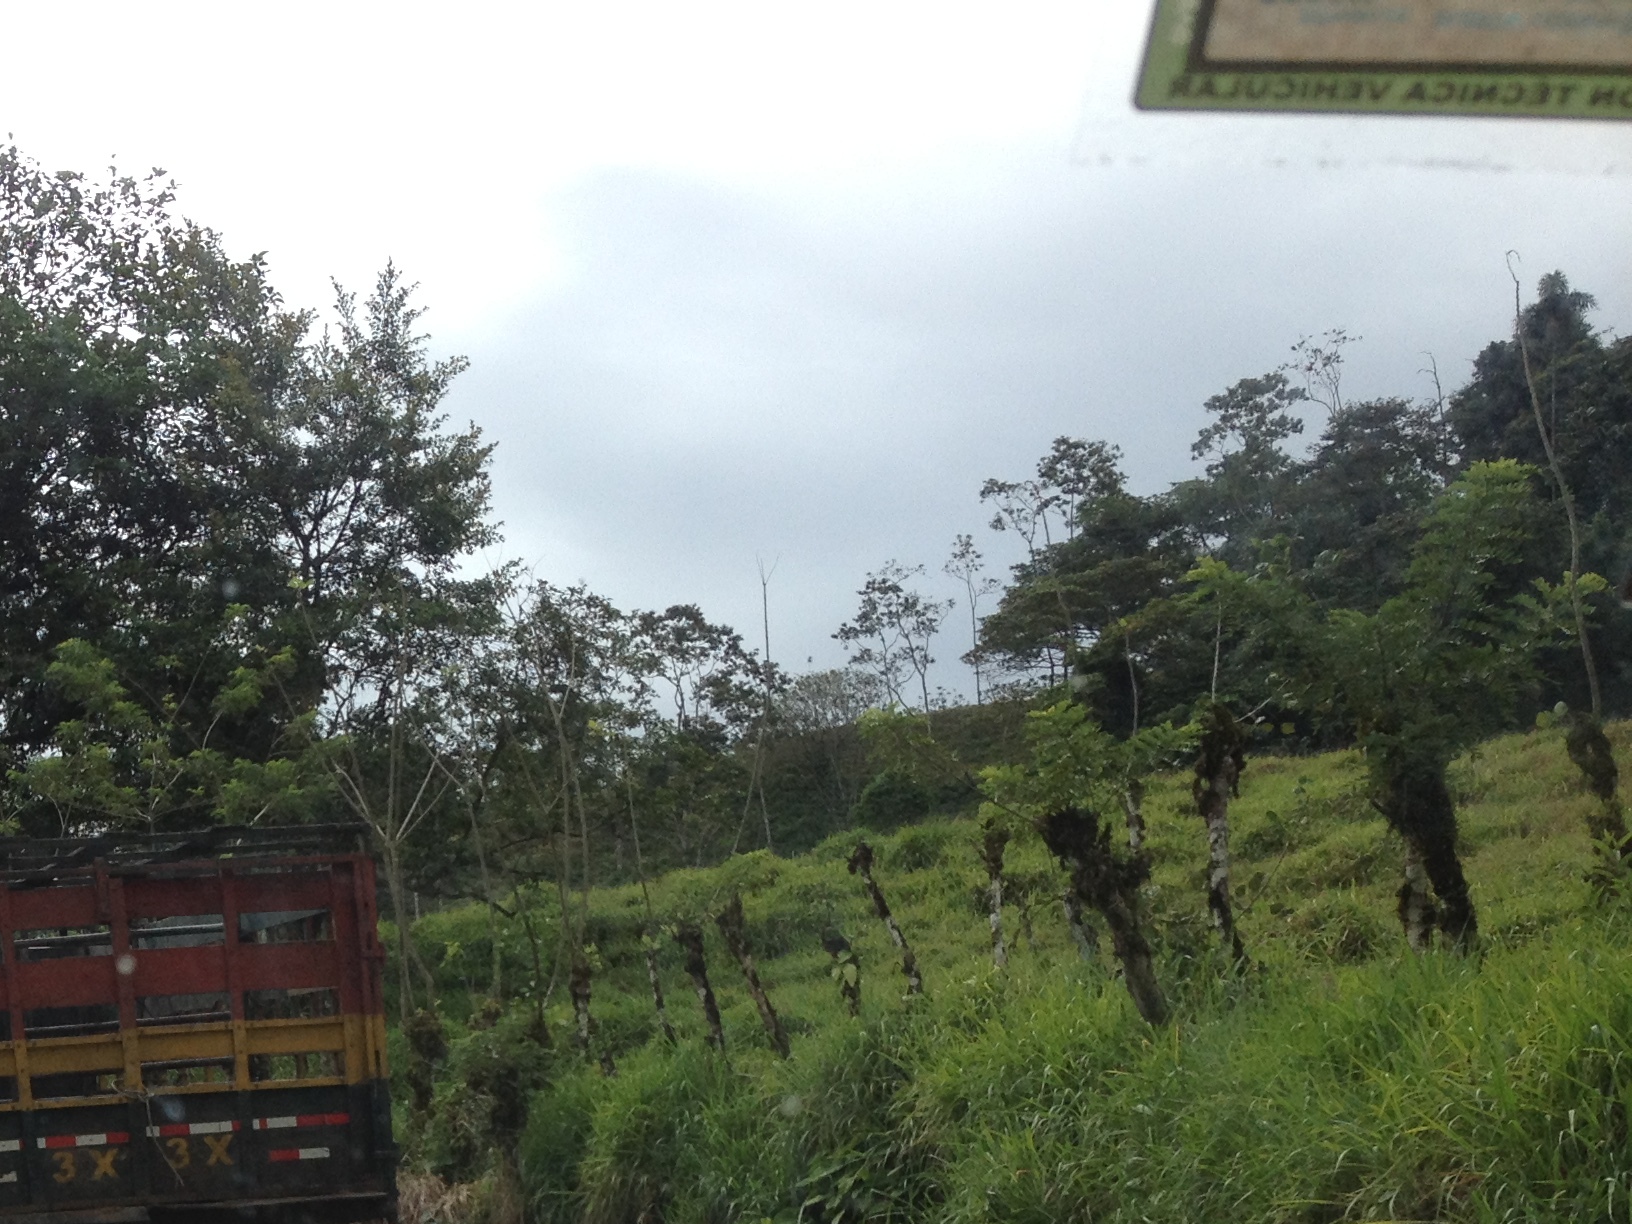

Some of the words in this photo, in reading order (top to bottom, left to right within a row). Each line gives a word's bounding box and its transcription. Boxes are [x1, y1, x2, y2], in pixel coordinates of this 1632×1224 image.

[52, 1151, 77, 1183] 3
[89, 1148, 120, 1181] X
[166, 1137, 190, 1169] 3
[204, 1134, 235, 1167] X
